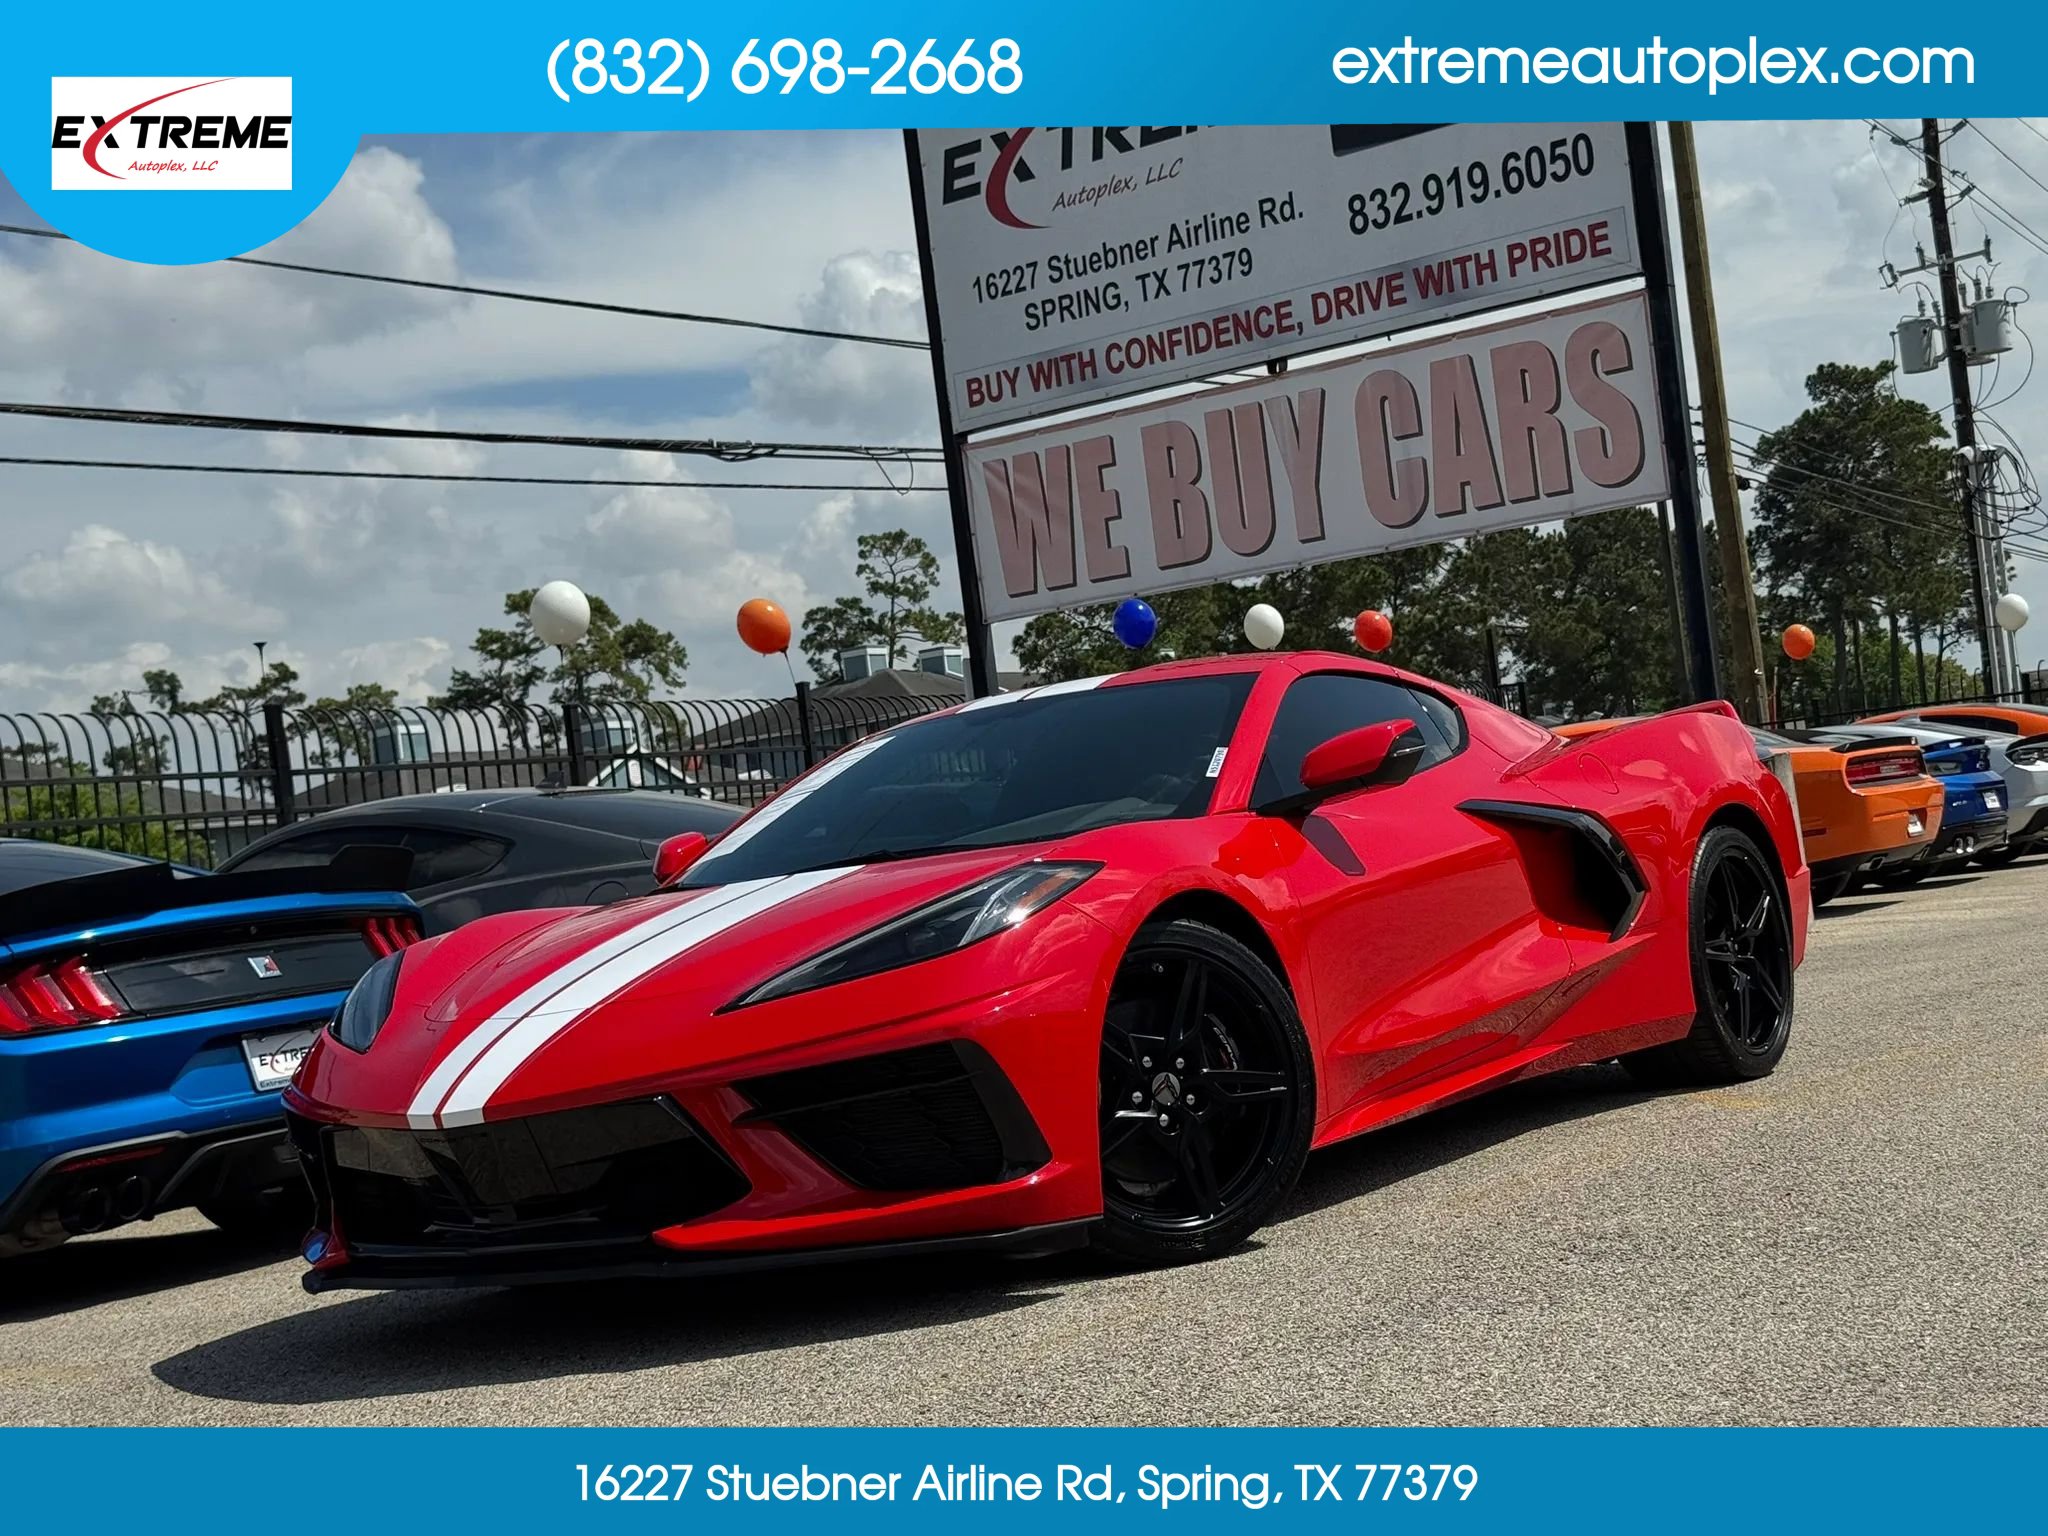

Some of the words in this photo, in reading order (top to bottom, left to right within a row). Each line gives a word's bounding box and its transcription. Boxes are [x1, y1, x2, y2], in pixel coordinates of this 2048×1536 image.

[942, 126, 1216, 205] EXTR
[1052, 174, 1137, 212] Autoplex,
[1145, 157, 1183, 186] LLC
[1348, 133, 1595, 235] 832.919.6050
[972, 261, 1039, 304] 16227
[1047, 233, 1160, 284] Stuebner
[1166, 210, 1250, 254] Airline
[1258, 191, 1304, 229] Rd.
[1024, 281, 1130, 331] SPRING,
[1135, 268, 1172, 302] TX
[1176, 247, 1253, 293] 77379
[966, 367, 1020, 408] BUY
[1027, 349, 1098, 392] WITH
[1105, 300, 1304, 374] CONFIDENCE,
[1311, 272, 1408, 326] DRIVE
[1412, 249, 1498, 300] WITH
[1506, 220, 1613, 278] PRIDE
[982, 434, 1132, 598] WE
[1140, 387, 1326, 570] BUY
[1353, 321, 1646, 530] CARS
